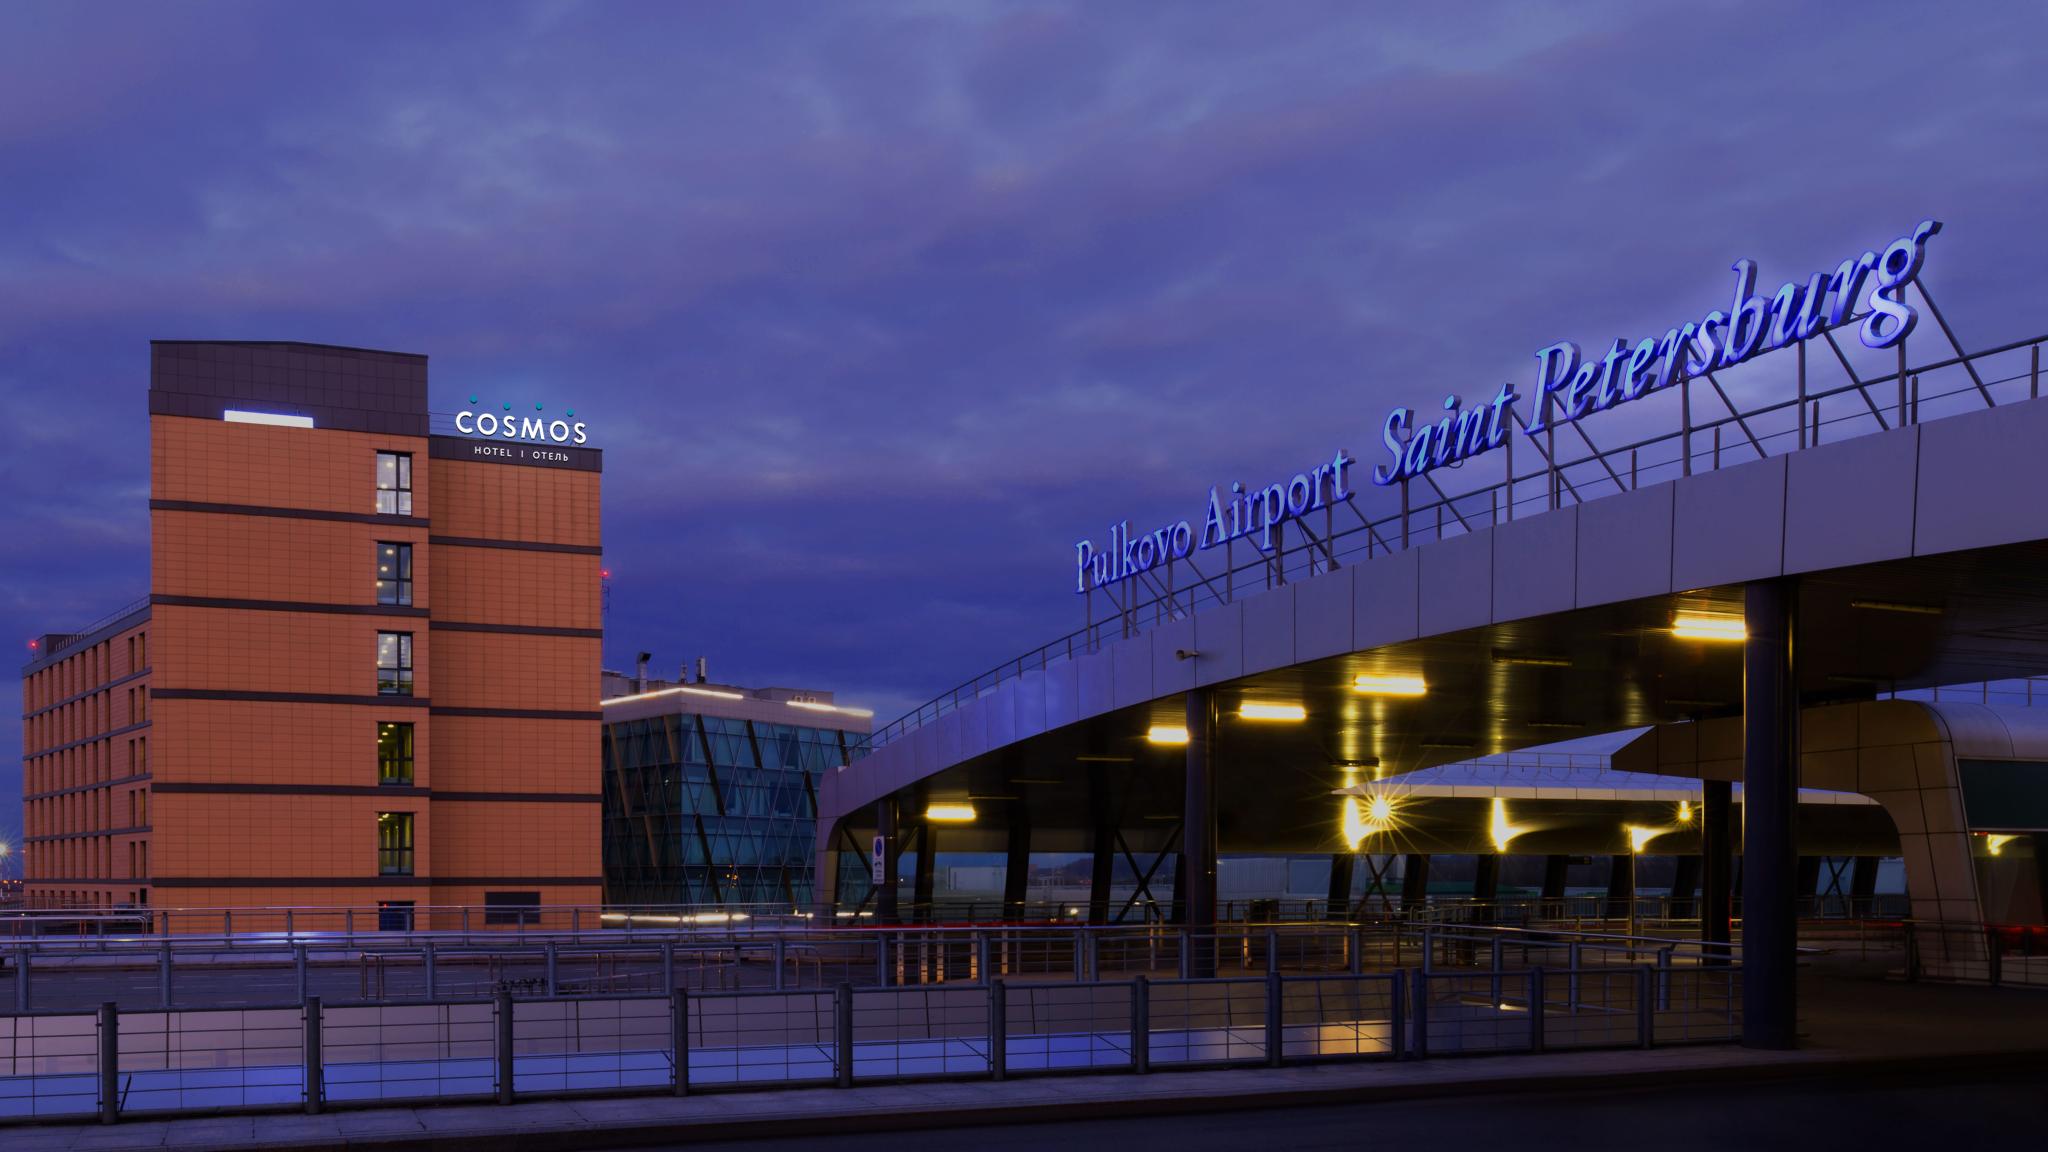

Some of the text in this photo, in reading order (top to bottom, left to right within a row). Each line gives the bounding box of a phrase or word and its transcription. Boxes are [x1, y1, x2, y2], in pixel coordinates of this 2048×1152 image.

[1075, 220, 1942, 594] Pulkovo Airport Saint Petersburg
[455, 411, 587, 444] COSMOS
[474, 446, 513, 457] HOTEL
[533, 451, 569, 462] ОТЕЛЬ
